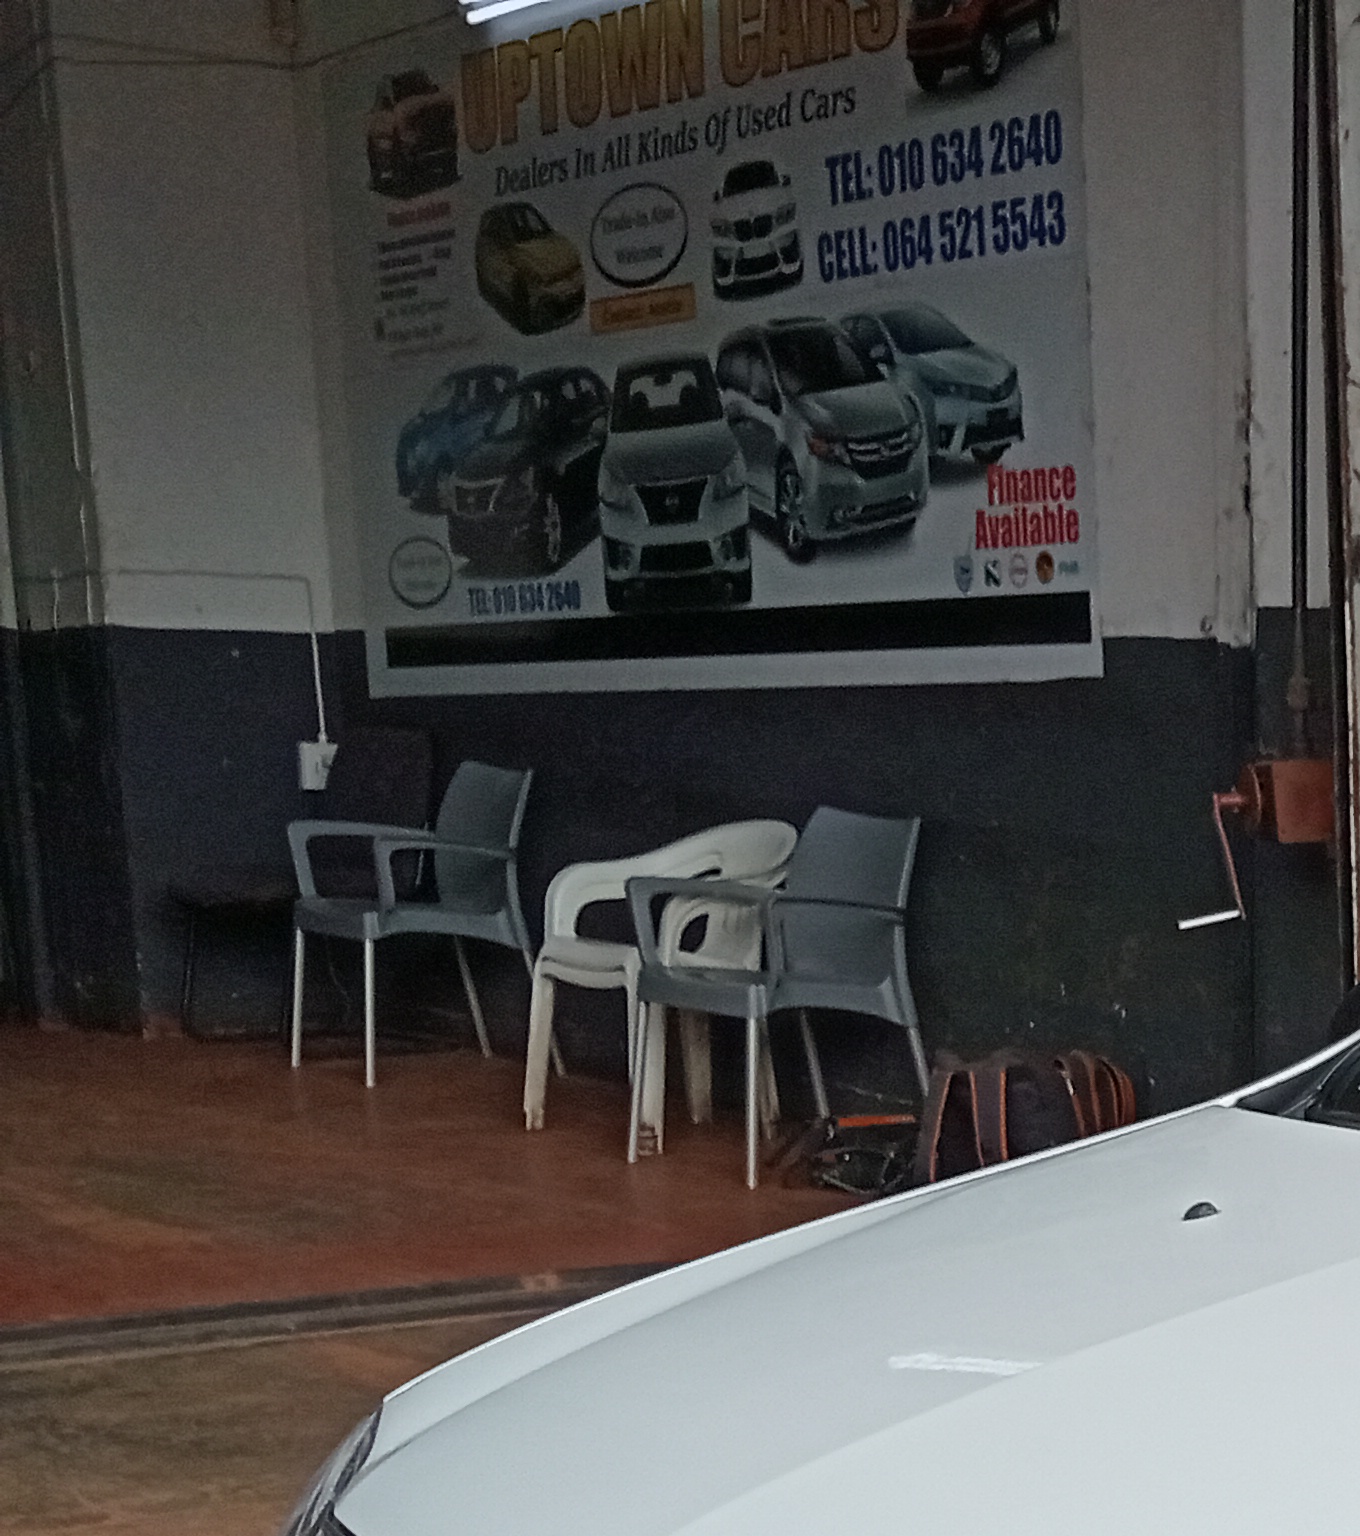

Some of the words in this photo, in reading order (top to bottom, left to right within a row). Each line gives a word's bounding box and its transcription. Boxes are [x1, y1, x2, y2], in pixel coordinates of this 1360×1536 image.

[460, 0, 705, 154] UPTOWN
[719, 0, 898, 87] CARS
[494, 156, 568, 197] Dealers
[575, 147, 596, 180] In
[603, 133, 631, 172] All
[637, 120, 699, 165] Kinds
[704, 107, 732, 155] Of
[736, 91, 792, 140] Used
[800, 86, 857, 123] Cars
[825, 151, 874, 206] TEL:
[878, 137, 925, 197] 010
[931, 125, 984, 187] 634
[989, 109, 1063, 176] 2640
[817, 226, 879, 283] CELL:
[883, 215, 933, 273] 064
[938, 205, 986, 262] 521
[992, 189, 1067, 256] 5543
[976, 504, 1080, 550] Available
[988, 464, 1077, 506] Finance
